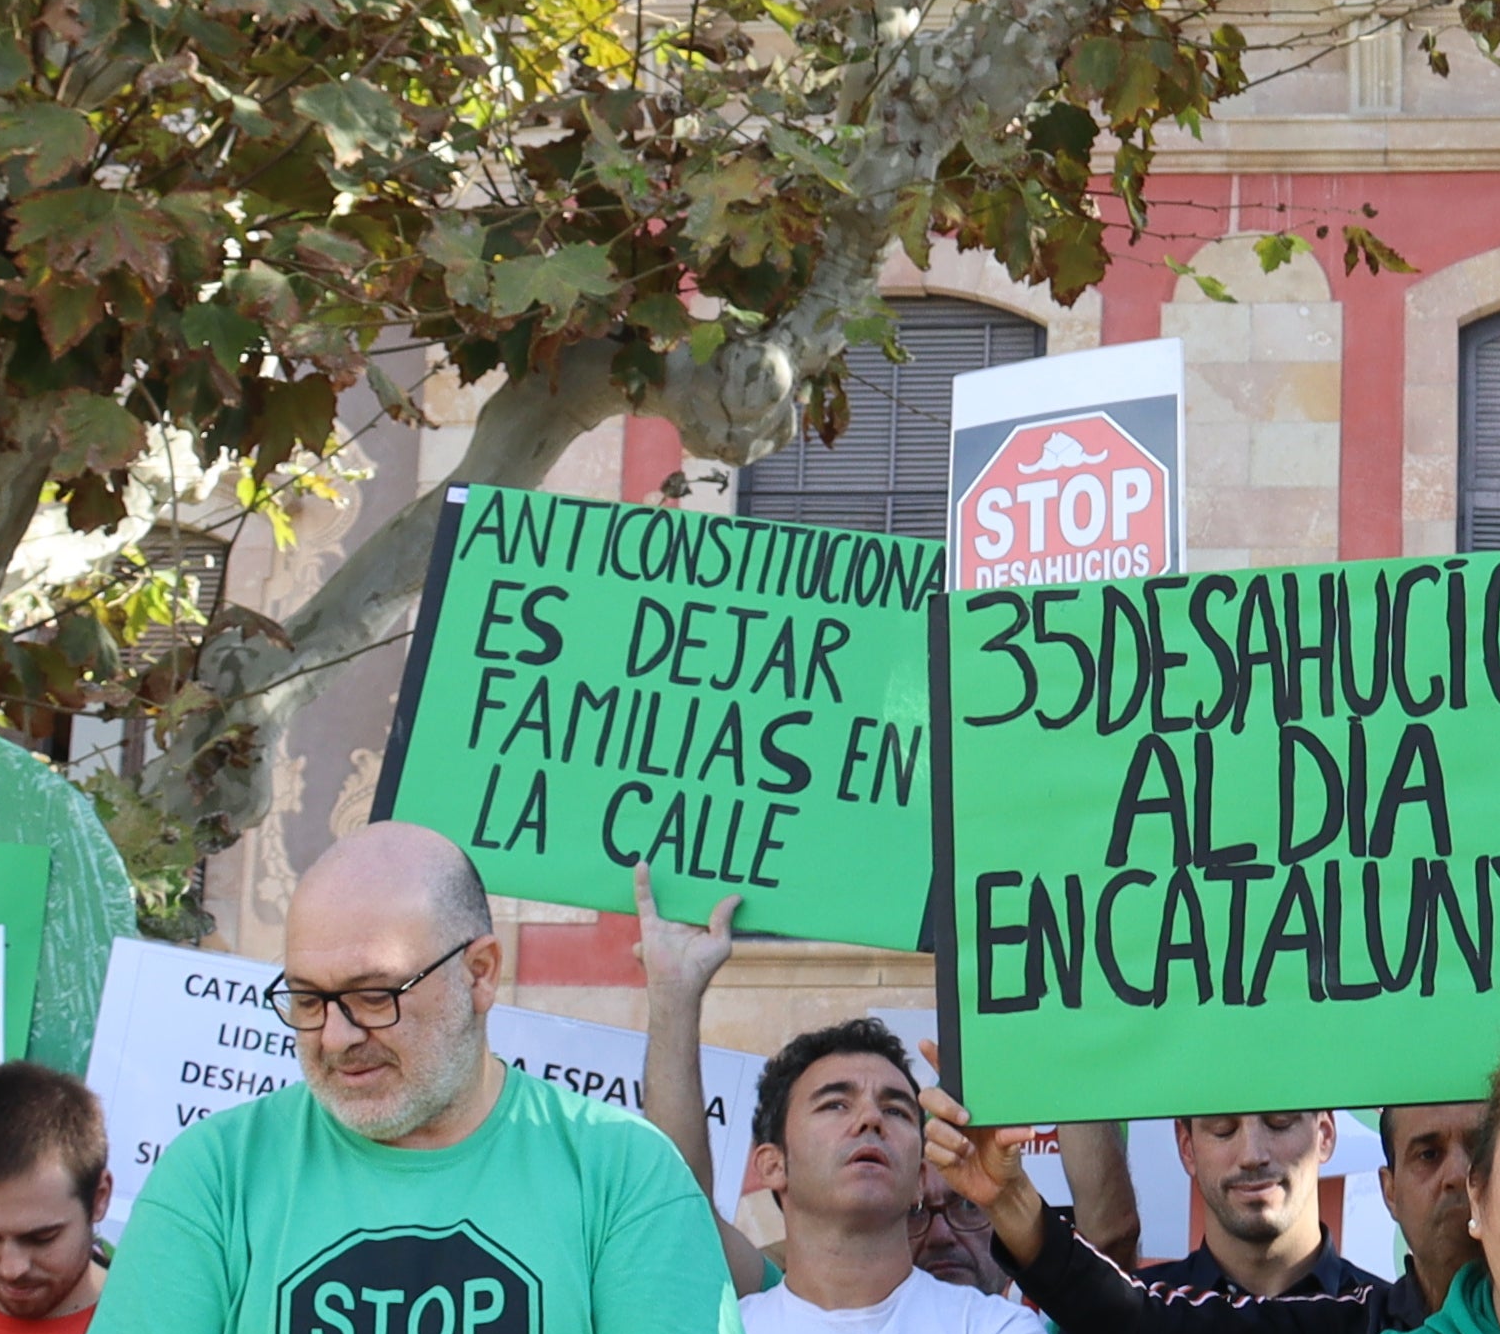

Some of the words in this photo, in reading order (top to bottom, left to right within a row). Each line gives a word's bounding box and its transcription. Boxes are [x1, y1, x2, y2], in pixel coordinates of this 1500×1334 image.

[459, 490, 946, 611] ANTICONSTITUCIONA
[974, 466, 1153, 561] STOP
[474, 580, 569, 666] ES
[626, 596, 850, 703] DEJAR
[964, 589, 1097, 729] 35
[468, 667, 813, 794] FAMILIAS
[836, 716, 922, 807] EN
[471, 763, 547, 854] LA
[602, 781, 800, 888] CALLE
[218, 1023, 296, 1060] LIDER
